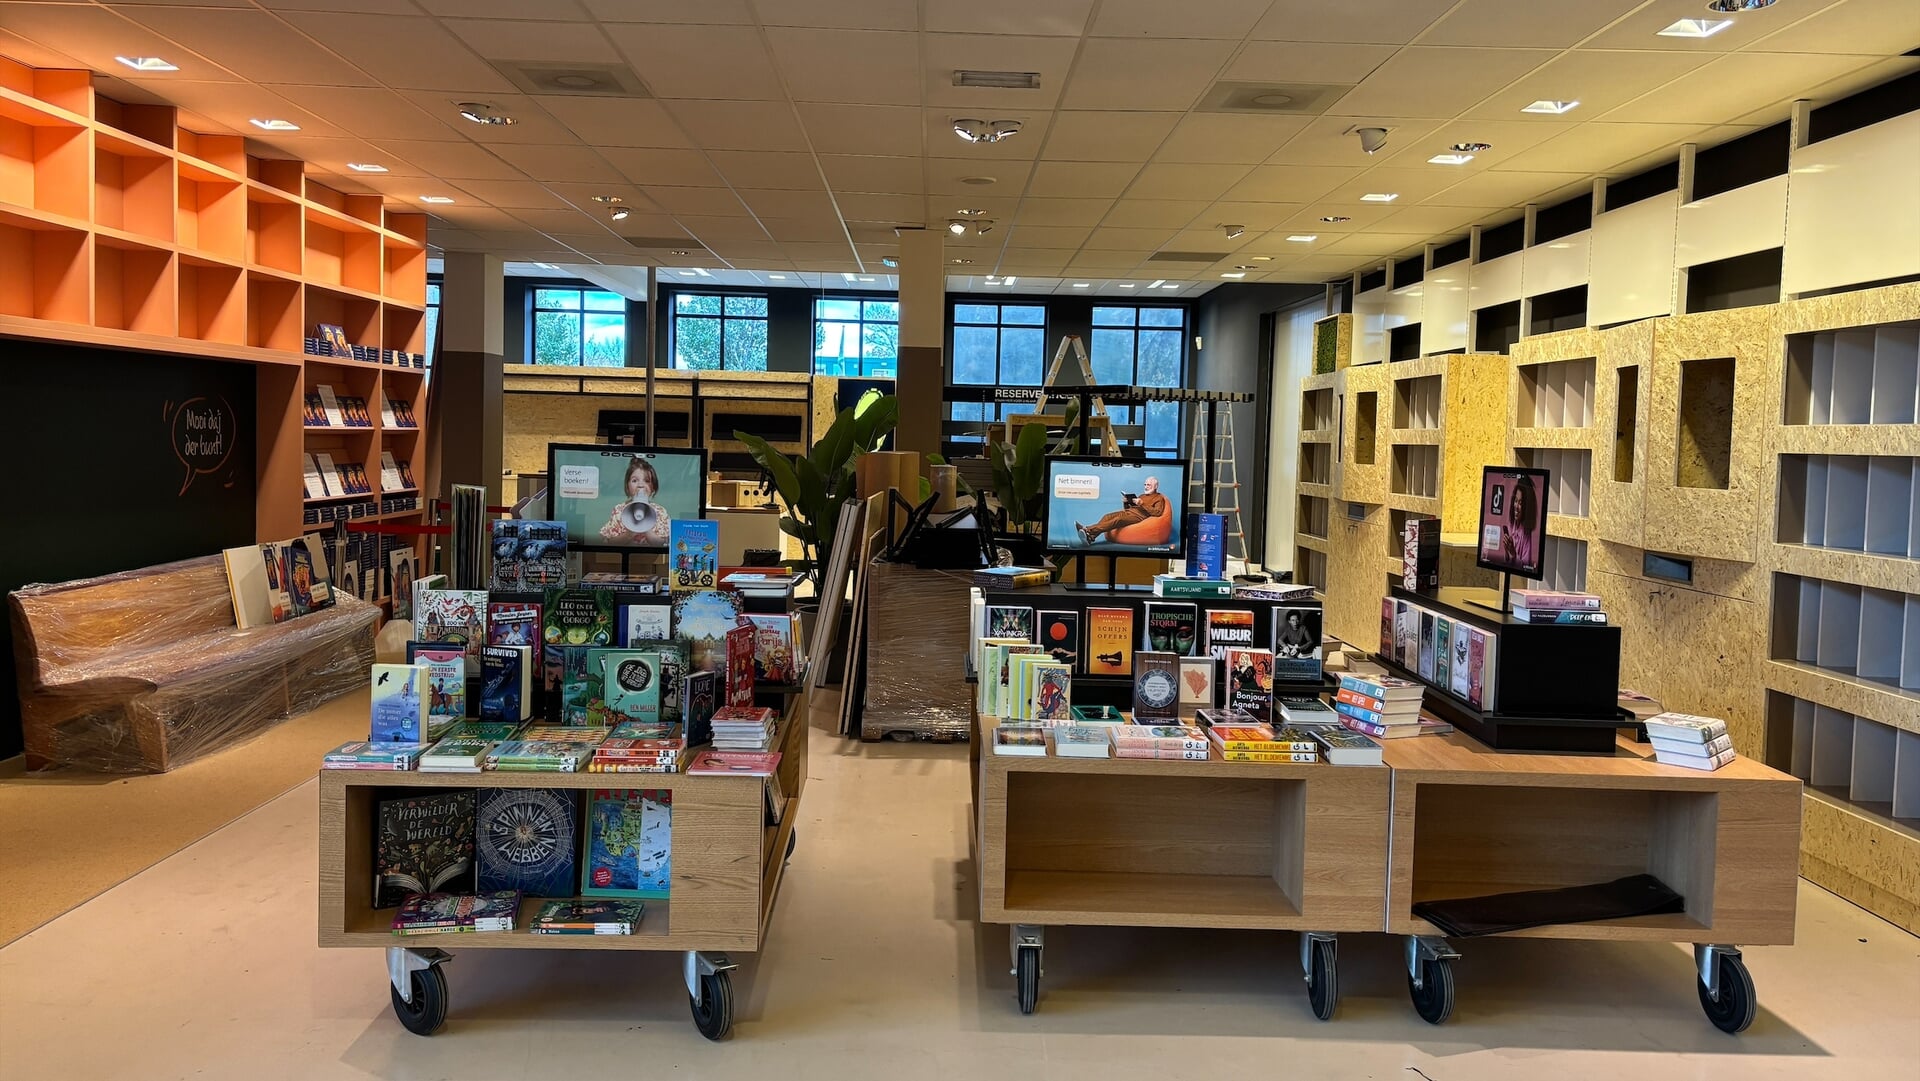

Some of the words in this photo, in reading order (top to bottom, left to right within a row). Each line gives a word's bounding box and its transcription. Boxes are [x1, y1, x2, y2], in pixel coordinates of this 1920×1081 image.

[186, 408, 207, 430] Mooi
[564, 468, 582, 476] Verse
[564, 476, 589, 484] boeken!
[560, 602, 574, 610] LEO
[562, 616, 591, 624] GORGO
[1150, 612, 1194, 620] TROPISCHE
[1150, 620, 1177, 628] STORM
[1210, 628, 1252, 641] WILBUR
[757, 636, 782, 649] Parijs
[483, 647, 486, 655] I
[487, 648, 518, 658] SURVIVED
[1236, 691, 1268, 702] Bonjour,
[1232, 700, 1260, 710] Agneta
[398, 803, 460, 821] VERWILDER
[409, 819, 424, 830] DE
[494, 804, 554, 836] SPINNEN
[405, 826, 452, 840] WERELD
[498, 838, 556, 863] WEBBEN
